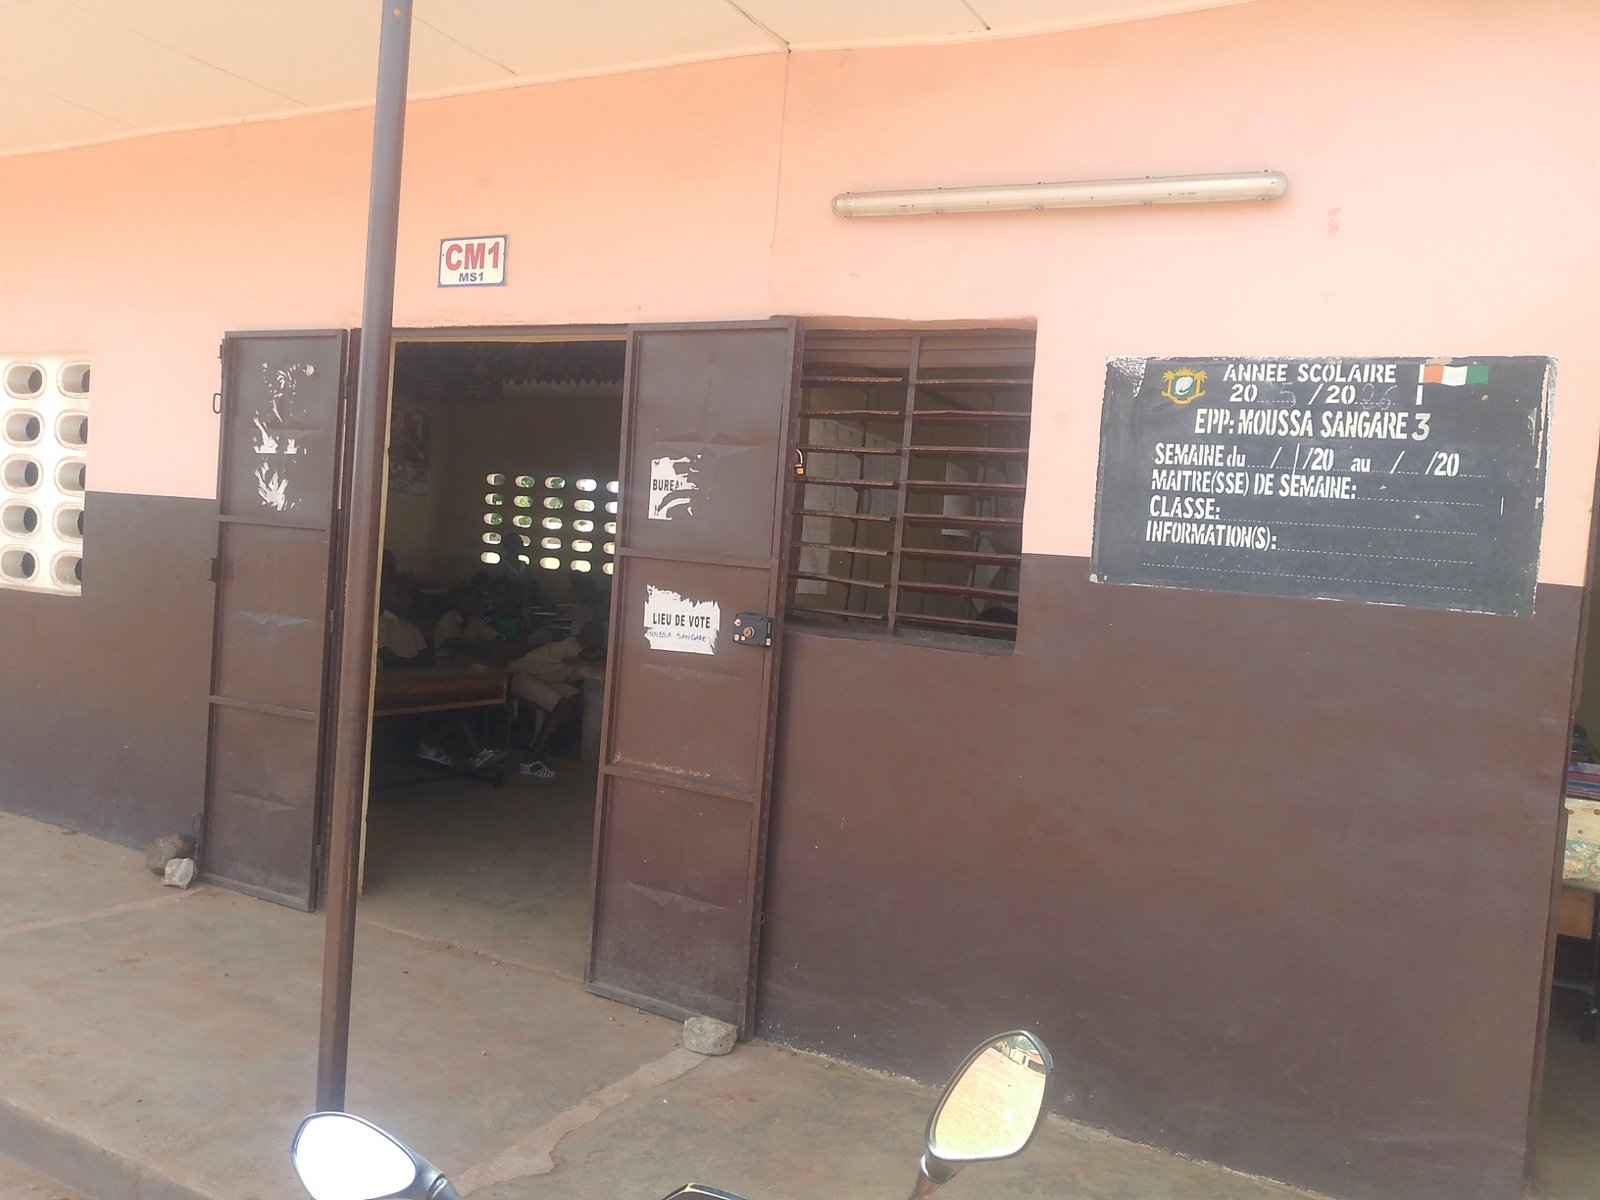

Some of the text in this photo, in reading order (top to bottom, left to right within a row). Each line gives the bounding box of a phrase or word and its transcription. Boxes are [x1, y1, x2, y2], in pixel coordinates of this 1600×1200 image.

[445, 241, 500, 271] CM1
[458, 272, 484, 282] MS1
[1223, 363, 1397, 383] ANNEE SCOLAIRE
[1237, 409, 1313, 437] MOUSSA
[1320, 410, 1409, 439] SANGARE
[1411, 413, 1431, 441] 3
[1154, 442, 1225, 467] SEMAINE
[1226, 445, 1246, 467] du
[1350, 457, 1371, 472] au
[652, 479, 684, 491] BUREA
[1151, 469, 1357, 500] MAITRE(SSE) DE SEMAINE:
[1150, 495, 1221, 519] CLASSE:
[1146, 520, 1277, 551] INFORMATION(S):
[652, 612, 711, 629] LIEU DE VOTE
